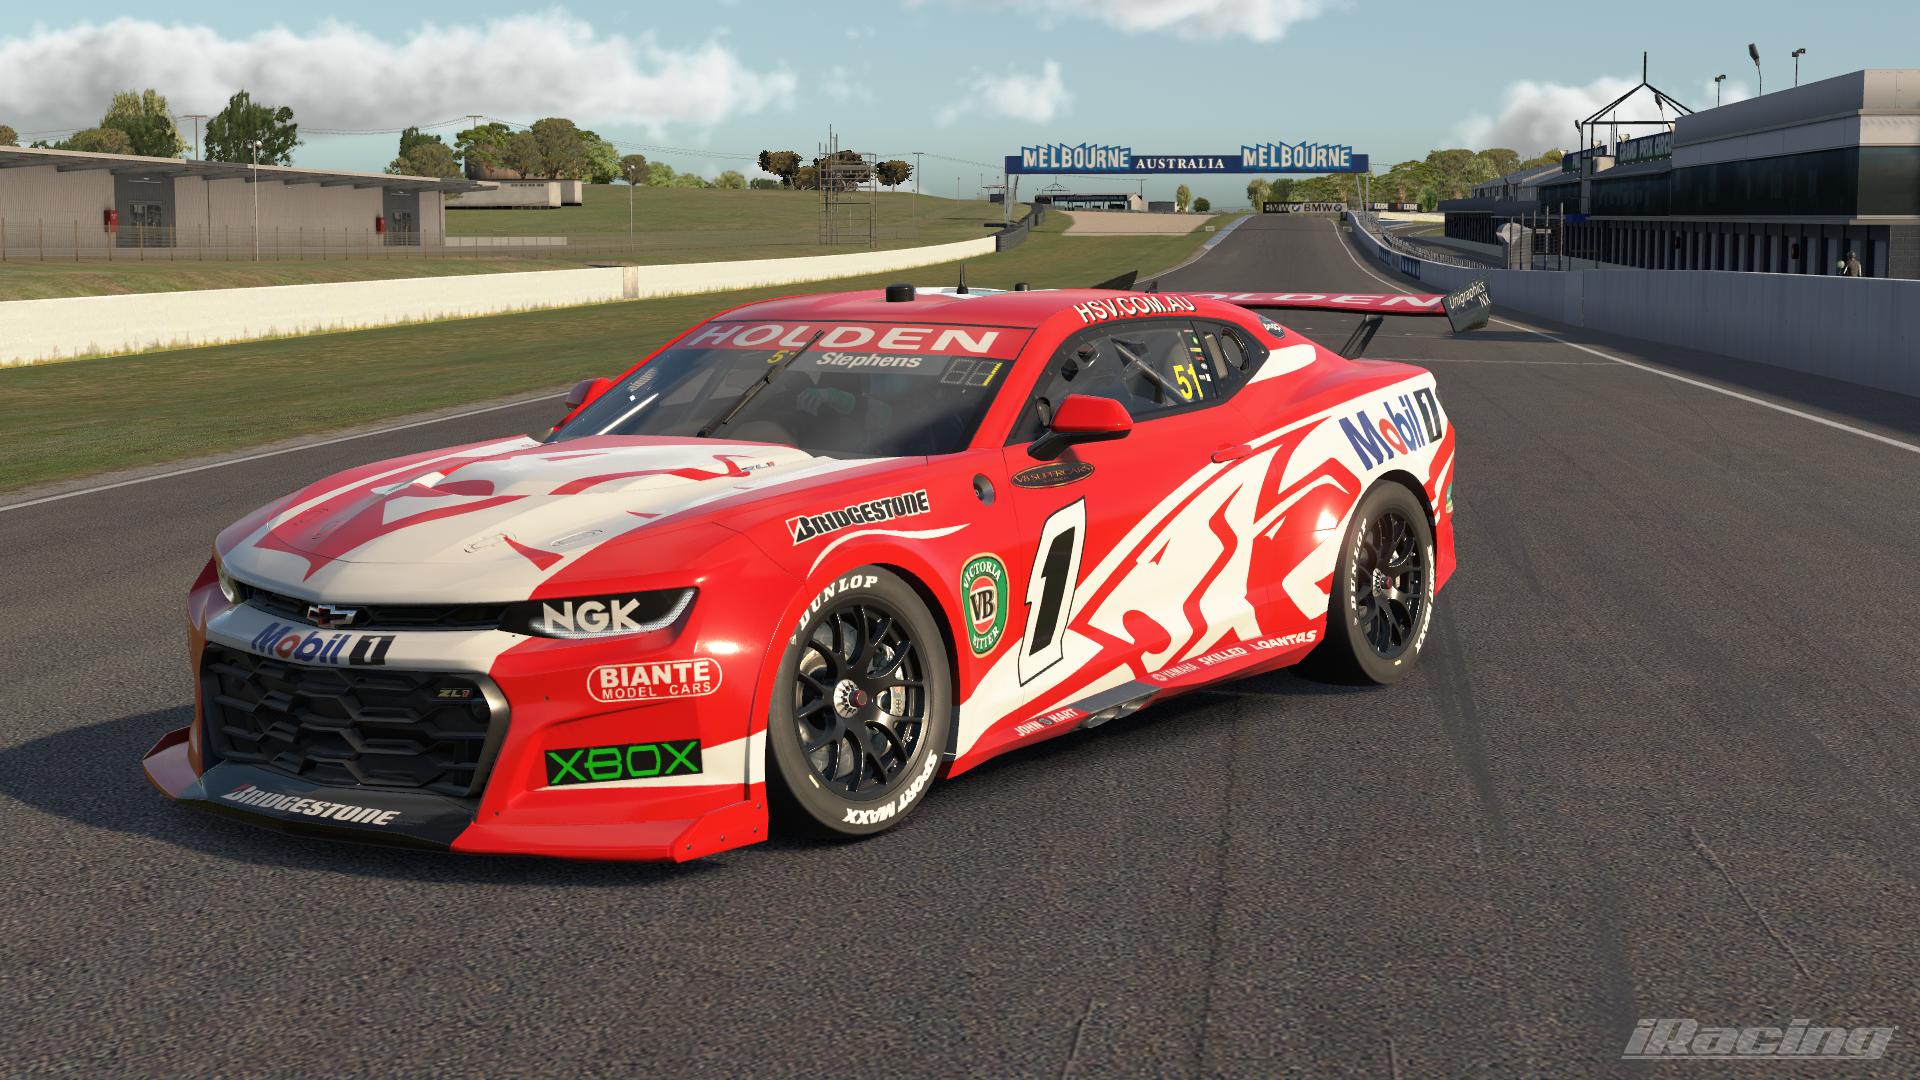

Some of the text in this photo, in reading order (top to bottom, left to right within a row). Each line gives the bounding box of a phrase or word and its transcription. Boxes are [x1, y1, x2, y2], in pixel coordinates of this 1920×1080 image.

[1023, 146, 1130, 168] MELBOURNE
[1136, 157, 1225, 169] AUSTRALIA
[1243, 145, 1351, 168] MELBOURNE
[1265, 203, 1290, 212] BMW
[1304, 203, 1332, 212] BMW
[1449, 280, 1486, 309] Unigraphics
[1478, 291, 1492, 308] NX
[1073, 296, 1195, 323] HSV.COM.AU
[687, 325, 999, 353] HOLDEN
[816, 352, 923, 368] Stephens
[1173, 363, 1203, 400] 51
[1339, 388, 1440, 471] Mobil 1
[788, 490, 930, 545] BRIDGESTONE
[963, 561, 1002, 588] VICTORIA
[799, 574, 878, 631] DUNLOP
[970, 589, 995, 621] VB
[1022, 507, 1082, 676] 1
[542, 598, 641, 633] NGK
[251, 622, 351, 664] Mobil
[972, 625, 1000, 649] BITTER
[1257, 629, 1318, 650] QANTAS
[1198, 646, 1248, 666] SKILLED
[600, 661, 711, 688] BIANTE
[1161, 662, 1201, 678] YAMAHA
[602, 681, 711, 699] MODEL CARS
[1014, 708, 1079, 737] JOHN HART
[547, 741, 699, 783] XBOX
[220, 784, 401, 825] BRIDGESTONE
[842, 801, 896, 825] MAXX
